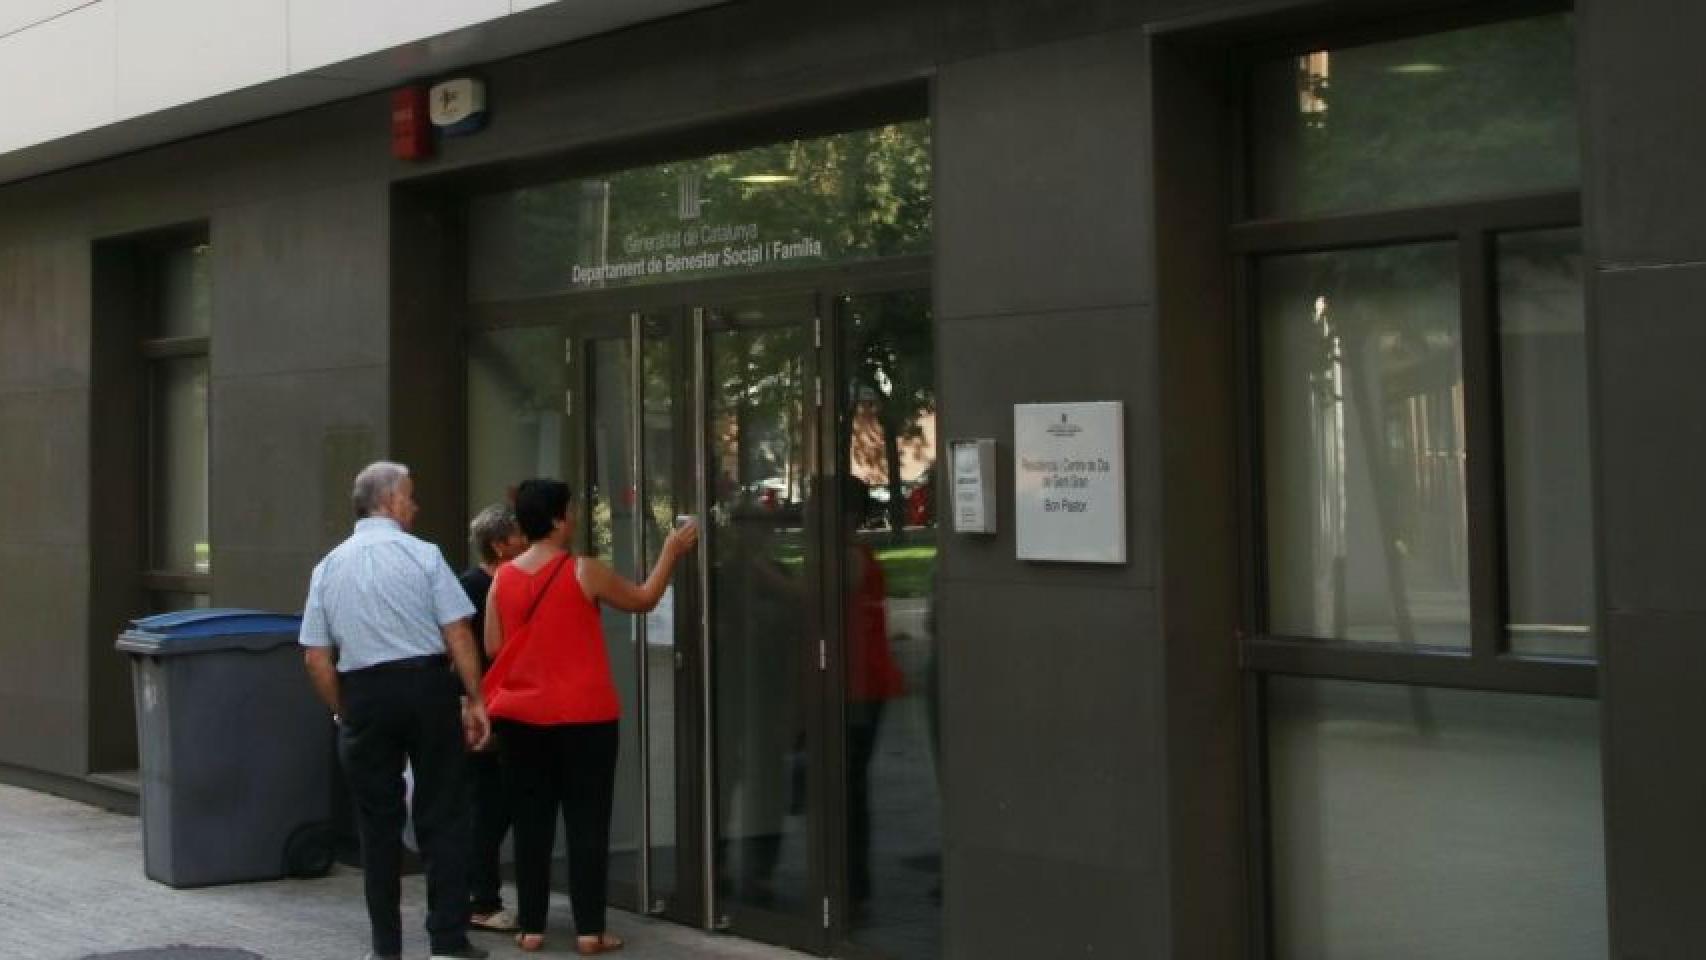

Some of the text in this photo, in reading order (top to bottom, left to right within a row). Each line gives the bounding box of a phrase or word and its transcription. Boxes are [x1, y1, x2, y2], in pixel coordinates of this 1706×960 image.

[624, 223, 759, 252] Generalitat de Catalunya
[572, 259, 645, 286] Departament
[648, 255, 663, 273] de
[665, 250, 721, 272] Benestar
[723, 242, 762, 266] Social
[774, 237, 821, 259] Família
